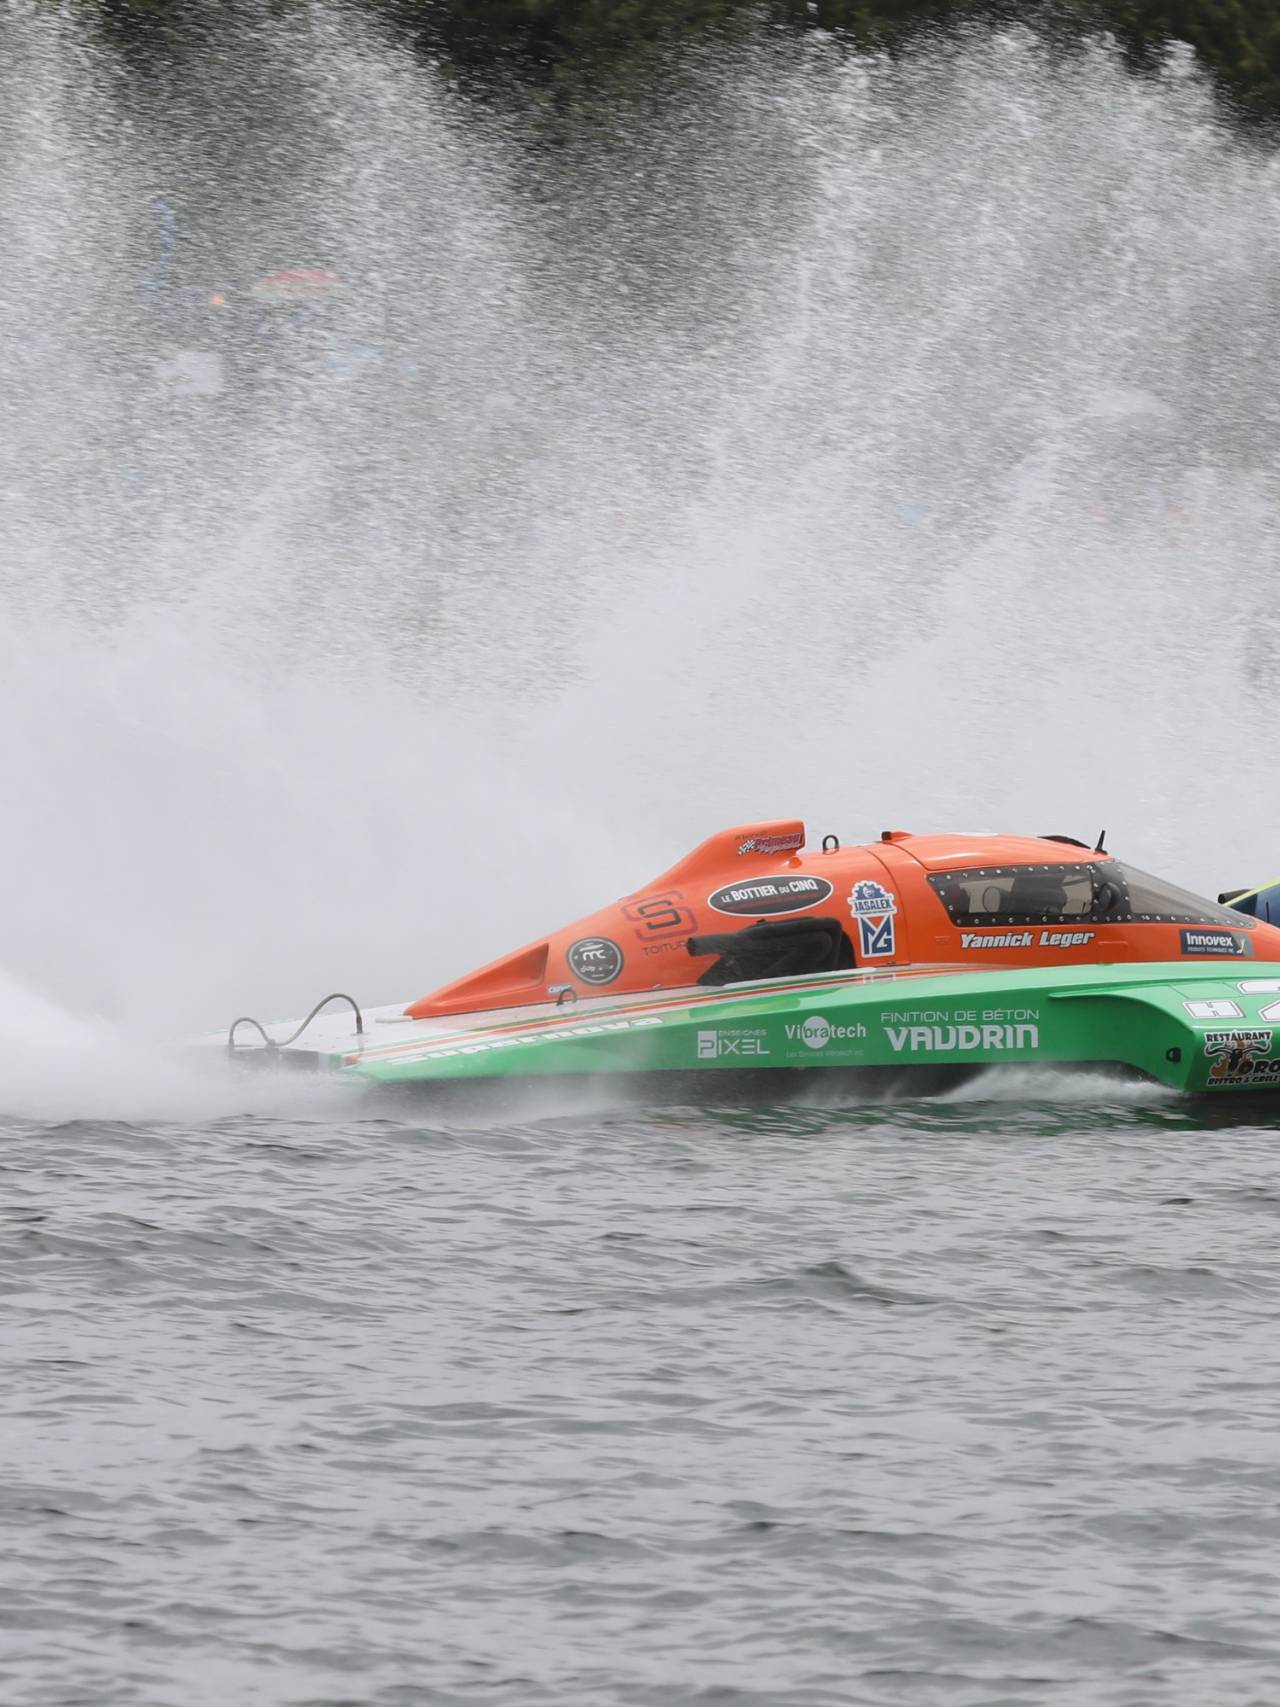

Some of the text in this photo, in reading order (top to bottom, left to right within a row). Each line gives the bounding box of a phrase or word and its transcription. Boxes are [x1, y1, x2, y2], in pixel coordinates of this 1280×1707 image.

[721, 894, 732, 903] LE
[730, 885, 778, 902] BOTTIER
[789, 879, 819, 893] CINQ
[855, 898, 892, 912] JASALEX
[960, 931, 1095, 949] Yannick Leger
[1186, 932, 1234, 947] Innovex
[880, 1008, 1040, 1023] FINITION DE BÉTON
[785, 1021, 867, 1041] Vibratech
[883, 1023, 1039, 1051] VAUDRIN
[1205, 1031, 1272, 1042] RESTAURANT
[384, 1017, 664, 1065] supernova
[698, 1036, 771, 1058] PIXEL
